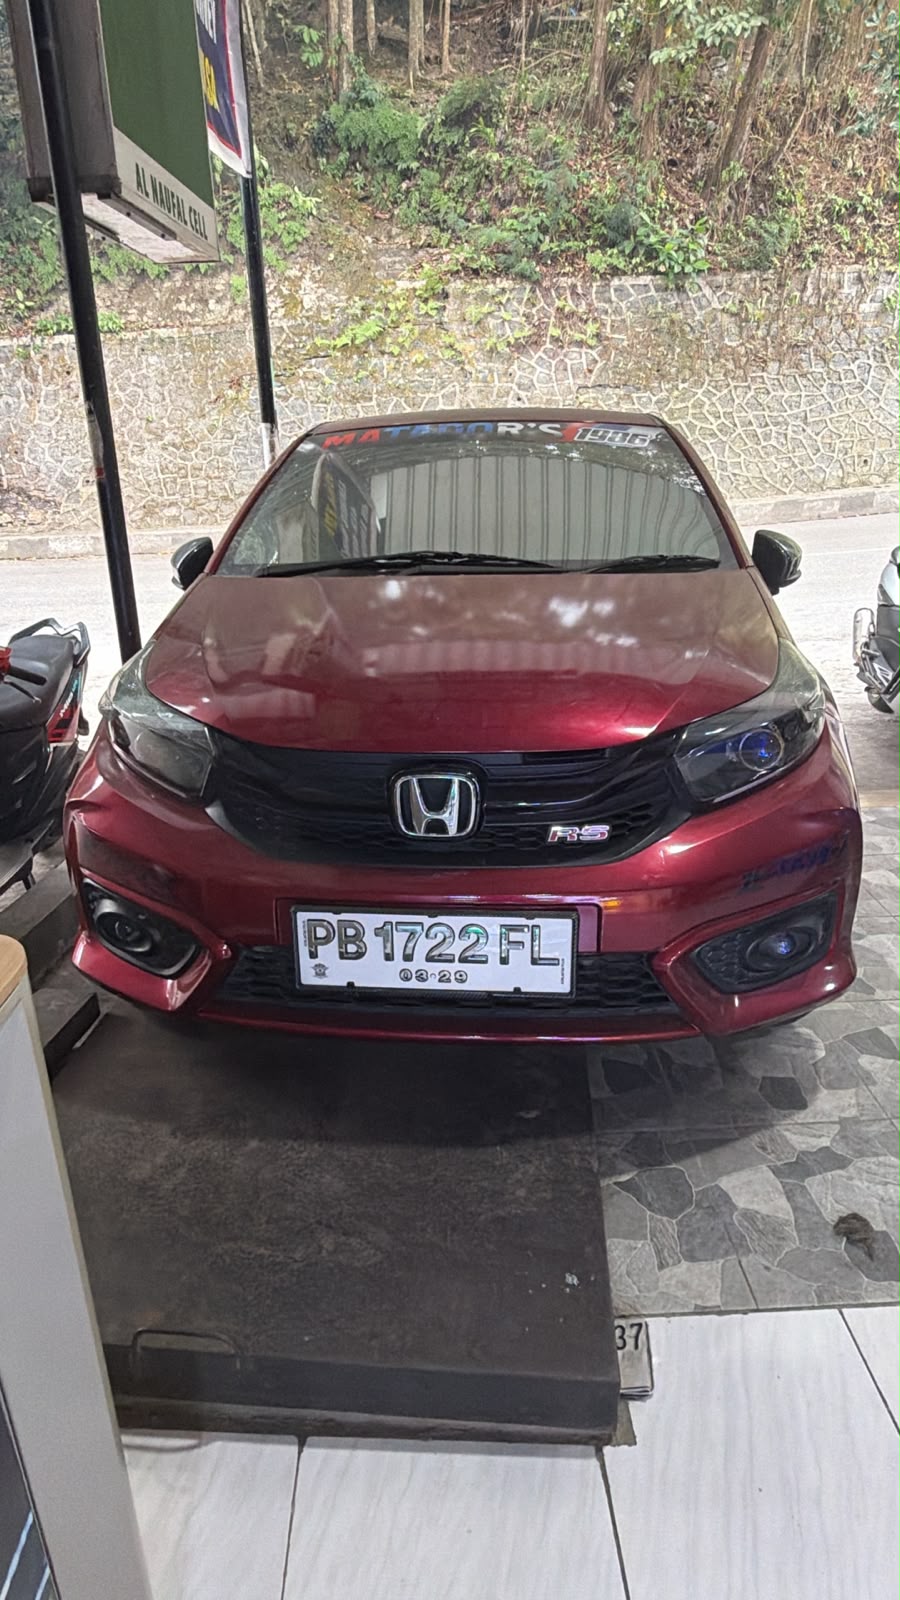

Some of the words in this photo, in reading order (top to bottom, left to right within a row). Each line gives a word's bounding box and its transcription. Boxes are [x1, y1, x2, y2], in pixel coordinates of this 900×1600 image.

[135, 162, 150, 198] AL
[150, 174, 188, 226] NAUFAL
[189, 205, 208, 240] CELL
[547, 824, 611, 842] RS
[306, 918, 368, 960] PB
[374, 921, 489, 964] 1722
[499, 925, 560, 966] FL
[614, 1322, 643, 1350] 37
